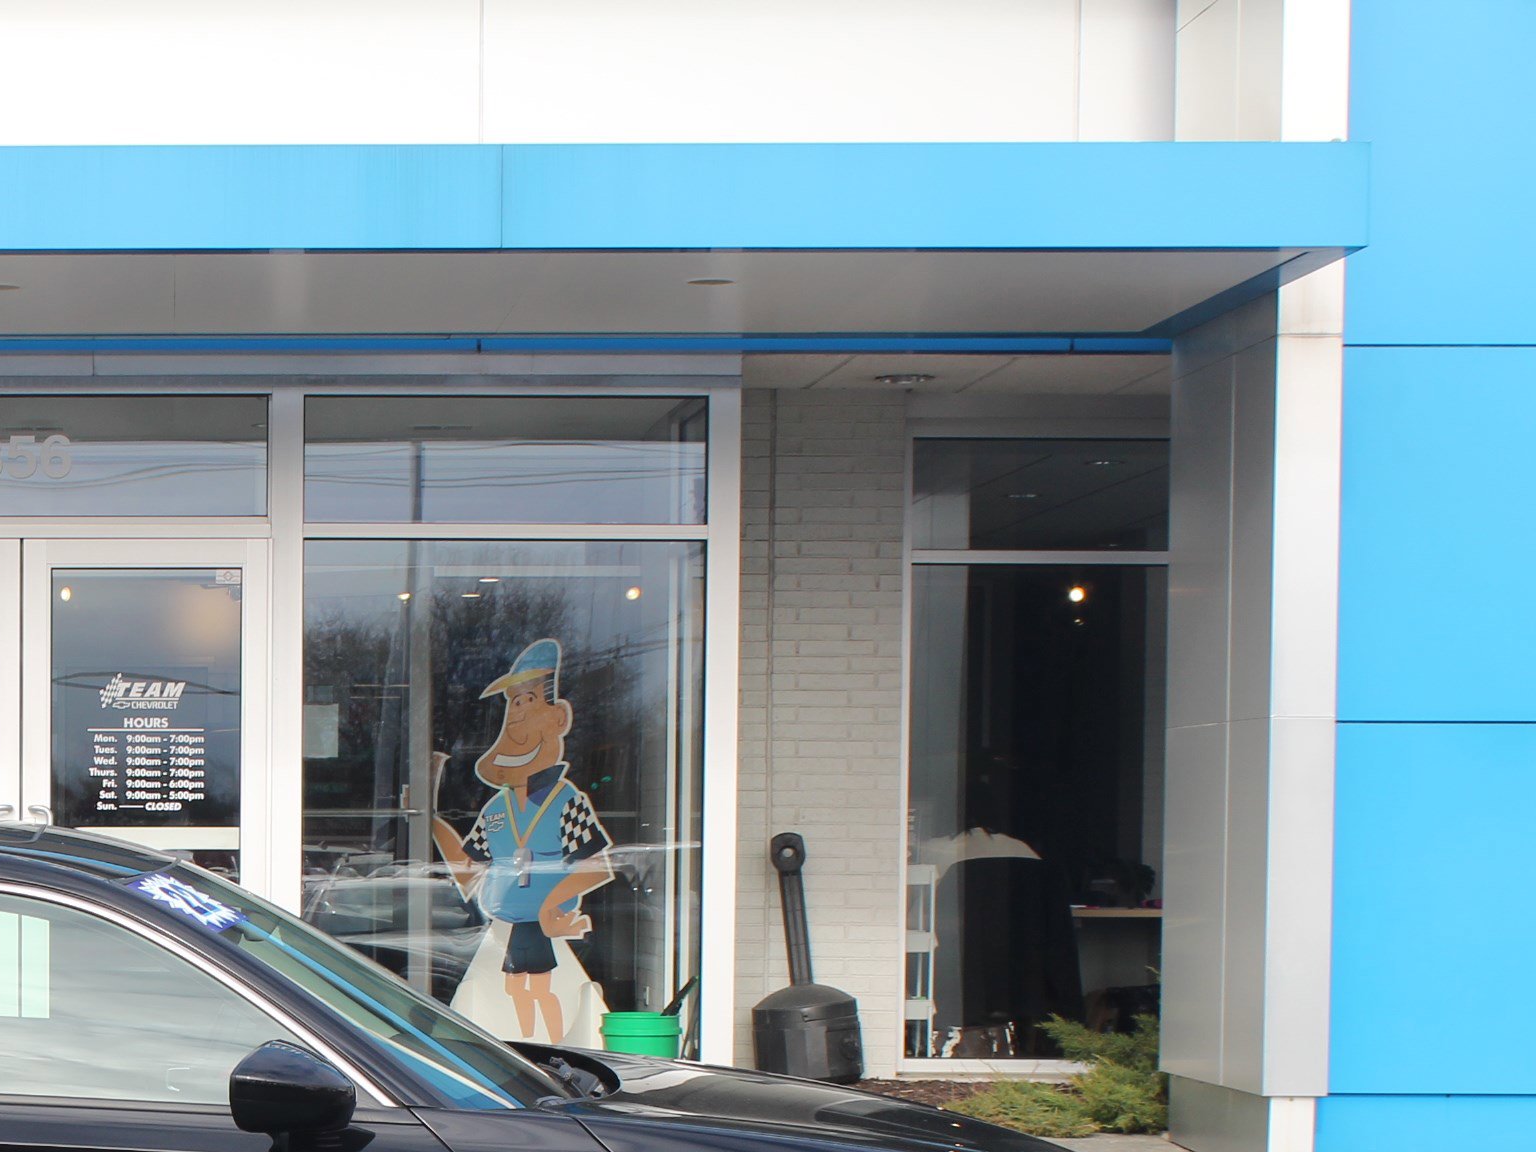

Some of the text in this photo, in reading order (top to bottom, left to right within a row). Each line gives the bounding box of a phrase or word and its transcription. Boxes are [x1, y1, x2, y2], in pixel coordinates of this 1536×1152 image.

[116, 682, 186, 698] TEAM
[131, 701, 178, 710] CHEVROLET
[123, 717, 169, 728] HOURS
[93, 734, 118, 743] Mon.
[125, 734, 161, 743] 9:00am
[169, 734, 205, 745] 7:00pm
[94, 745, 118, 754] Tues.
[125, 745, 161, 754] 9:00am
[169, 745, 205, 756] 7:00pm
[93, 757, 118, 766] Wed.
[125, 757, 161, 766] 9:00am
[169, 757, 205, 767] 7:00pm
[89, 768, 118, 777] Thurs.
[125, 768, 161, 777] 9:00am
[169, 768, 205, 778] 7:00pm
[102, 779, 118, 788] Fri.
[125, 779, 161, 788] 9:00am
[169, 779, 205, 790] 6:00pm
[99, 790, 118, 800] Sat.
[125, 790, 161, 800] 9:00am
[169, 790, 205, 801] 5:00pm
[96, 802, 182, 811] Sun. CLOSED
